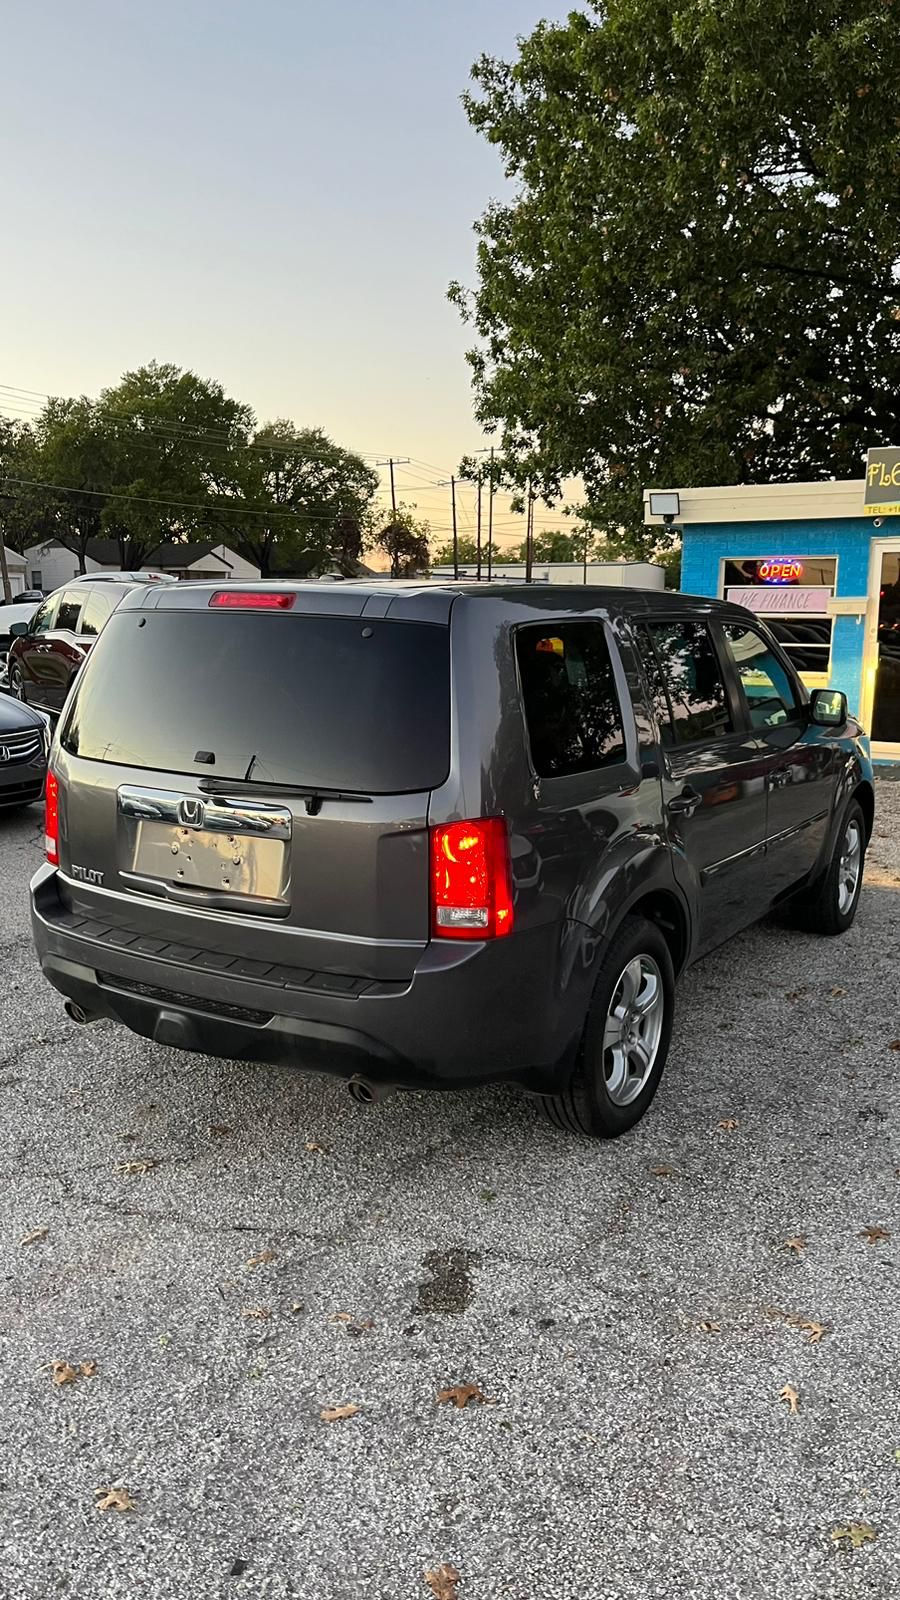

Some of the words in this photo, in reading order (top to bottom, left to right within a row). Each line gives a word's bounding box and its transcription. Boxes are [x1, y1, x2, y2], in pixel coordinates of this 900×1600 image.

[760, 564, 800, 577] OPEN
[761, 592, 813, 609] FINANCE
[71, 864, 104, 884] PILOT
